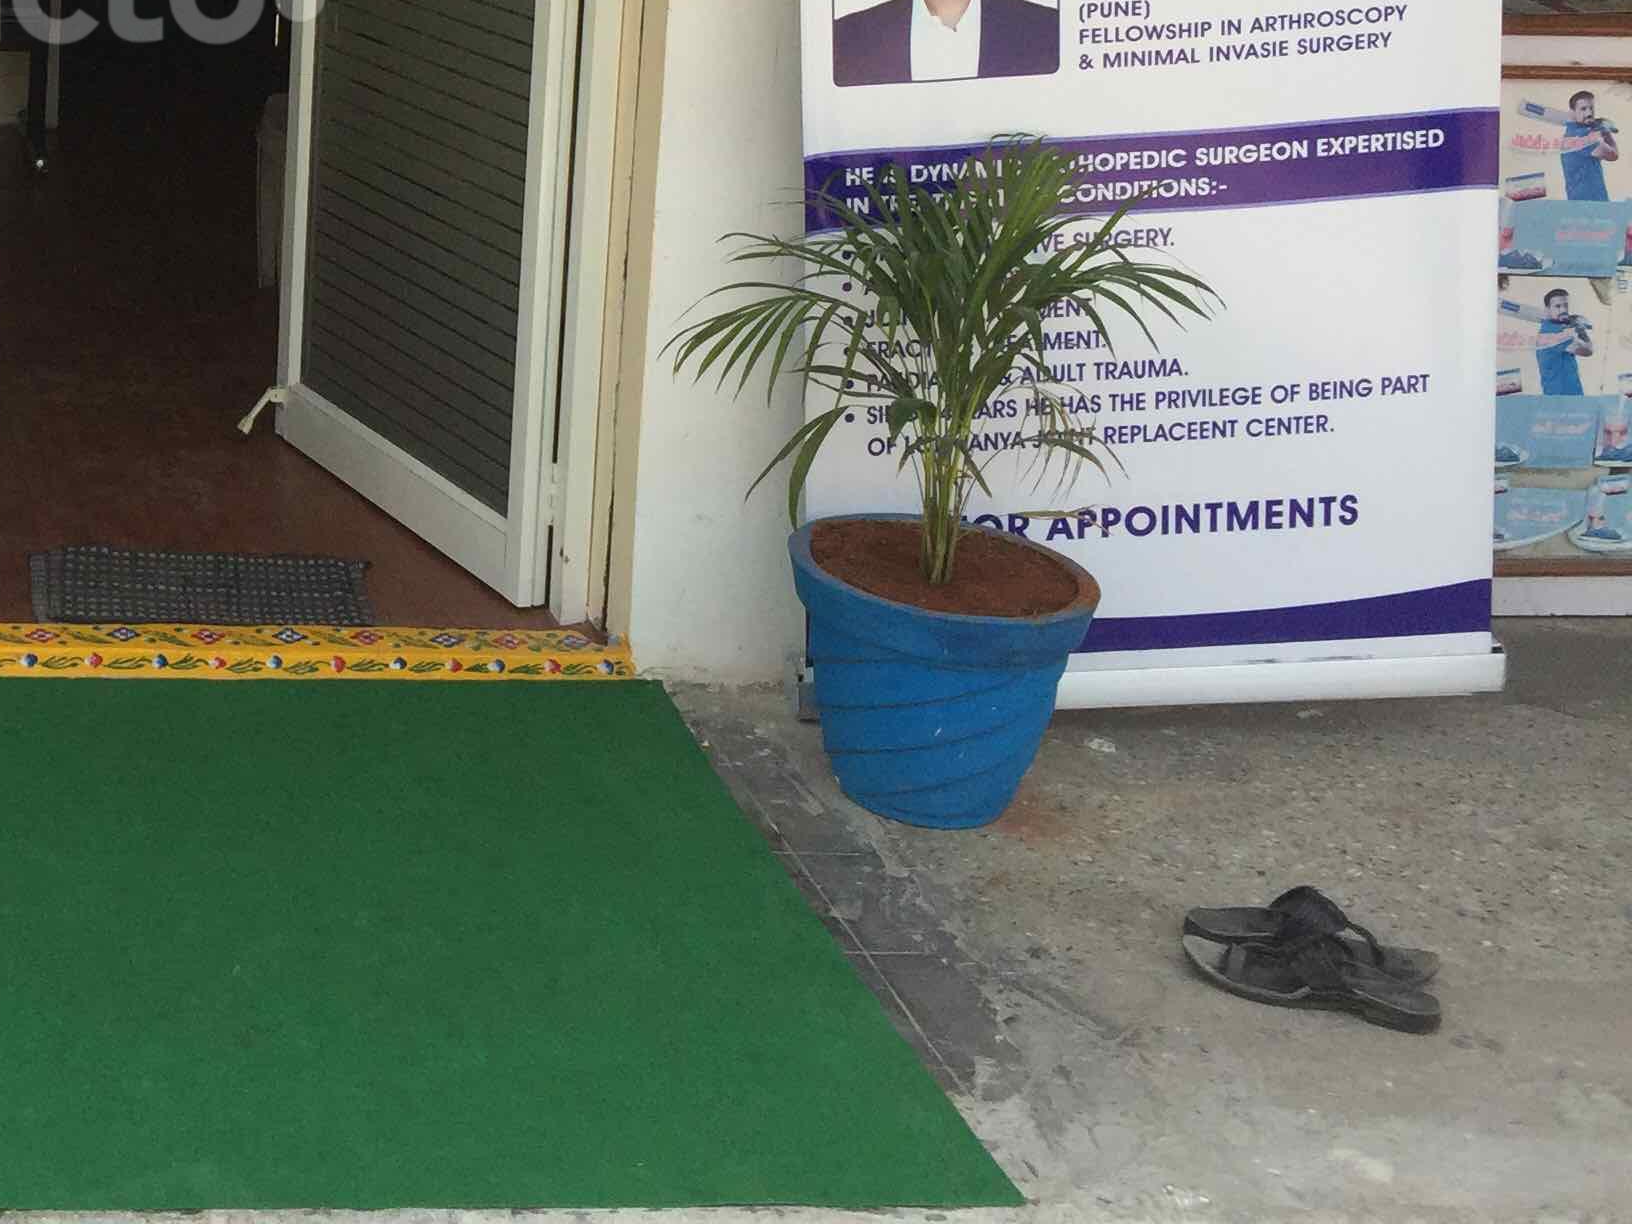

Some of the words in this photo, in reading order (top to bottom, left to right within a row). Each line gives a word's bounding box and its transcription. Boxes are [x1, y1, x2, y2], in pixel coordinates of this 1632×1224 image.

[1079, 0, 1151, 24] (PUNE)
[1079, 20, 1212, 45] FELLOWSHIP
[1220, 19, 1242, 37] IN
[1249, 4, 1408, 35] ARTHROSCOPY
[1078, 54, 1094, 71] &
[1102, 47, 1200, 69] MINIMAL
[1209, 40, 1289, 63] INVASIE
[1297, 31, 1393, 56] SURGERY
[845, 167, 874, 187] HE
[1195, 140, 1308, 167] SURGEON
[1316, 128, 1445, 157] EXPERTISED
[1094, 358, 1189, 380] TRAUMA.
[1062, 395, 1101, 414] HAS
[1109, 393, 1146, 411] THE
[1155, 386, 1262, 409] PRIVILEGE
[1270, 384, 1301, 404] OF
[1309, 378, 1373, 400] BEING
[1380, 374, 1431, 396] PART
[1103, 420, 1238, 445] REPLACEENT
[1245, 414, 1335, 438] CENTER.
[1046, 493, 1359, 541] APPOINTMENTS
